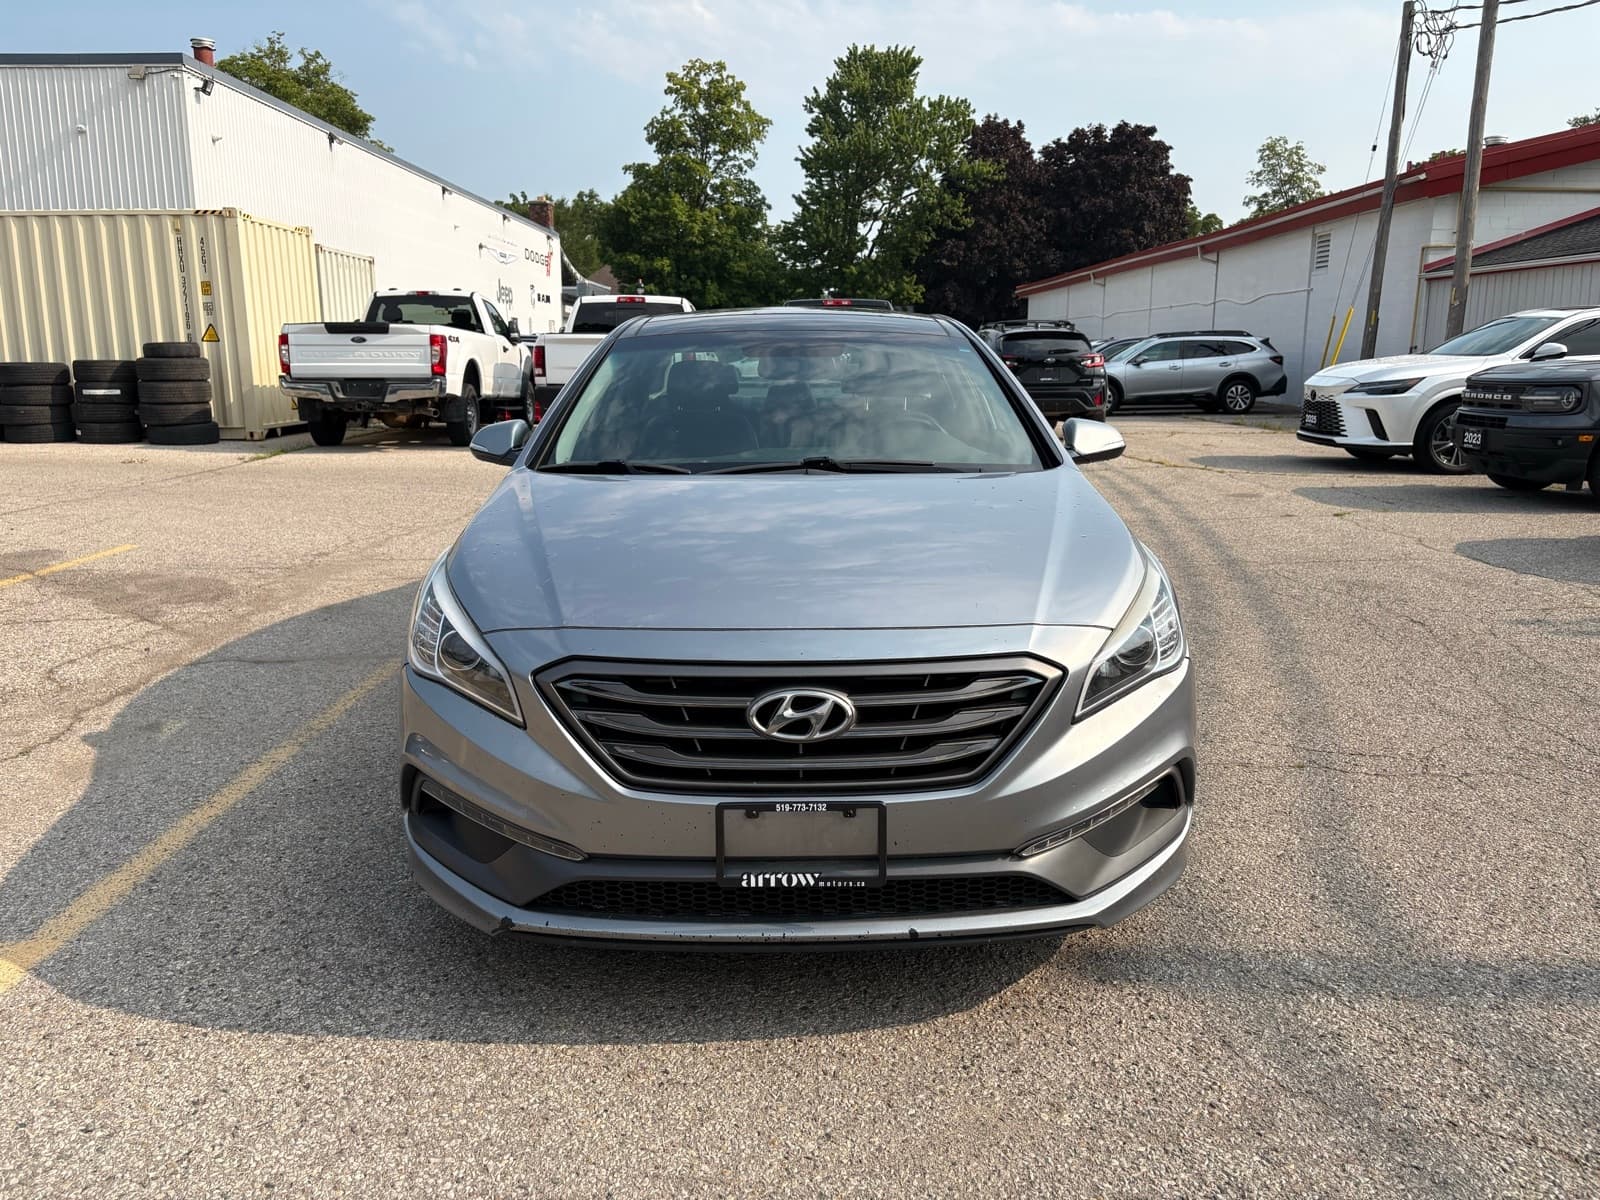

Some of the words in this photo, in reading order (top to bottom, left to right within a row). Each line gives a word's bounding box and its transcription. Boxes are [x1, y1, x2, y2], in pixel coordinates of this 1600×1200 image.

[525, 248, 549, 267] DODGE
[497, 278, 513, 310] Jeep
[537, 293, 551, 304] RAM
[1465, 392, 1512, 401] BRONCO
[1463, 432, 1481, 444] 2023
[776, 803, 827, 812] 519-773-7132
[741, 873, 821, 888] arrow
